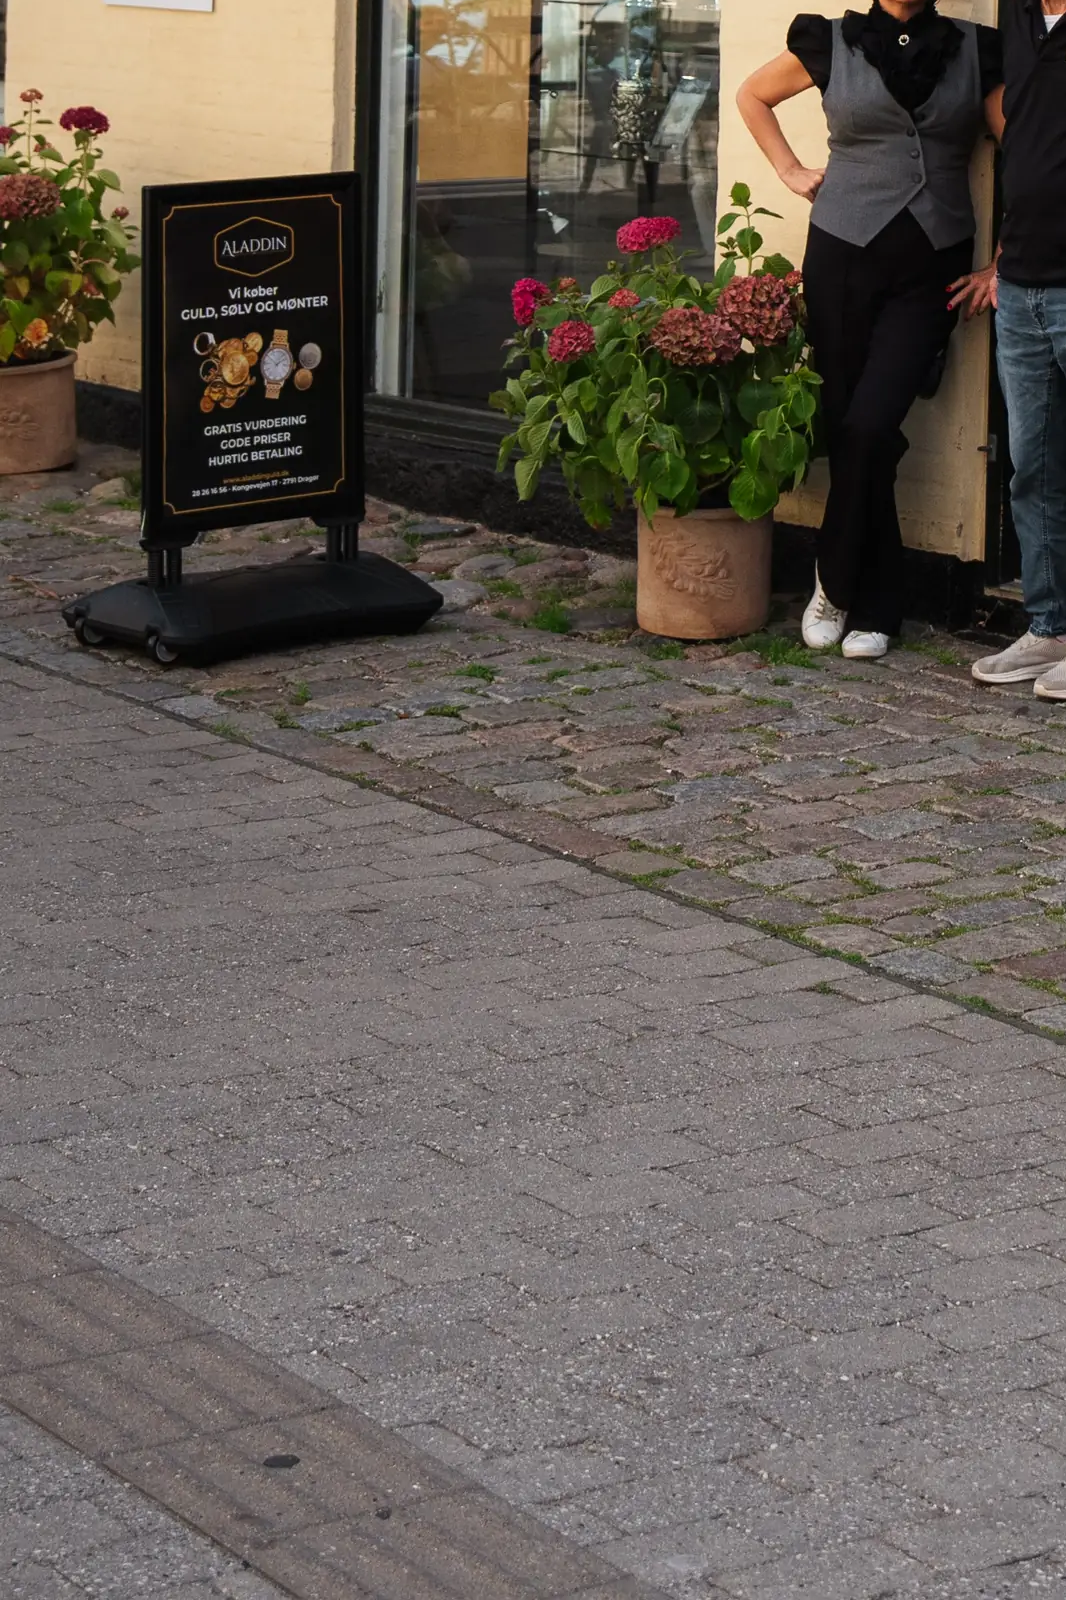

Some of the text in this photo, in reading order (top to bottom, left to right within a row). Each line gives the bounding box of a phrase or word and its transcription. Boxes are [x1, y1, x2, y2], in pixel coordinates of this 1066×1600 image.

[221, 236, 287, 257] ALADDIN
[228, 285, 278, 299] Vi køber
[181, 295, 329, 320] GULD, SØLV OG MØNTER
[204, 414, 307, 436] GRATIS VURDERING
[220, 432, 291, 450] GODE PRISER
[208, 446, 303, 467] HURTIG BETALING
